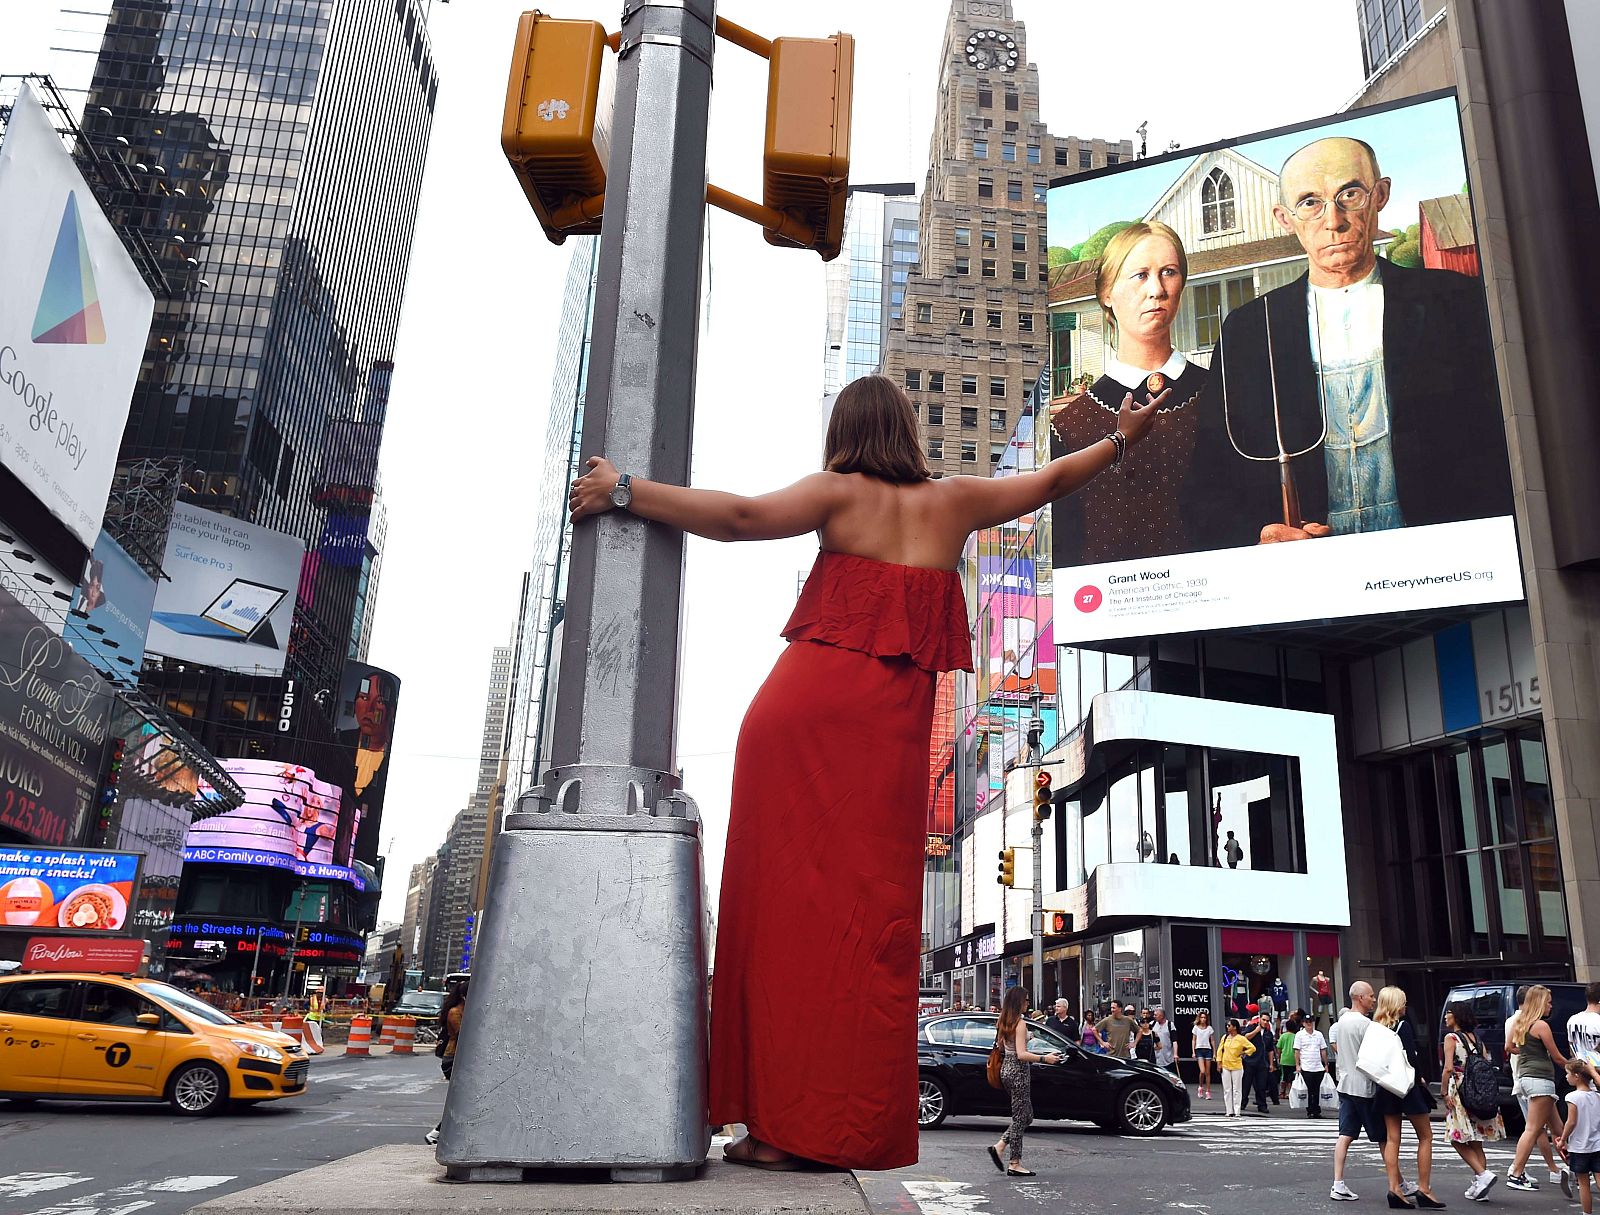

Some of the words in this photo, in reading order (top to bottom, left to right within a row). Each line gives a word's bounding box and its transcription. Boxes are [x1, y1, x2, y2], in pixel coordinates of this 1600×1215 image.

[0, 346, 57, 433] Google
[55, 420, 87, 471] play
[184, 513, 211, 528] tablet
[213, 522, 231, 535] that
[233, 530, 249, 540] can
[198, 530, 219, 541] your
[221, 534, 253, 552] laptop.
[175, 548, 208, 565] Surface
[209, 557, 226, 570] Pro
[227, 562, 233, 571] 3
[1108, 574, 1136, 584] Grant
[1140, 569, 1170, 580] Wood
[1365, 571, 1493, 590] ArtEverywhereUS.org
[1108, 586, 1150, 596] American
[1186, 577, 1208, 588] 1930
[1124, 595, 1134, 603] Art
[1136, 593, 1162, 603] Institute
[1164, 591, 1172, 599] of
[1174, 589, 1203, 601] Chicago
[1083, 594, 1093, 603] 27
[0, 626, 63, 712] Romeo
[56, 675, 106, 746] Santos
[1485, 676, 1541, 716] 1515
[278, 680, 294, 732] 1500
[19, 704, 66, 752] FORMULA
[67, 736, 81, 763] VOL
[80, 748, 87, 765] 2
[1, 789, 66, 846] 2.25.2014
[33, 855, 42, 863] a
[45, 854, 85, 866] splash
[90, 857, 117, 867] with
[194, 850, 215, 860] ABC
[217, 851, 253, 864] Family
[308, 865, 315, 876] &
[318, 865, 349, 880] Hungry
[47, 868, 95, 879] snacks!
[185, 922, 199, 933] the
[201, 923, 243, 935] Streets
[246, 925, 256, 936] in
[309, 933, 322, 942] 30
[1178, 968, 1204, 977] YOU'VE
[1174, 981, 1209, 990] CHANGED
[1175, 994, 1186, 1003] SO
[1187, 995, 1209, 1003] WE'VE
[112, 1047, 127, 1065] T
